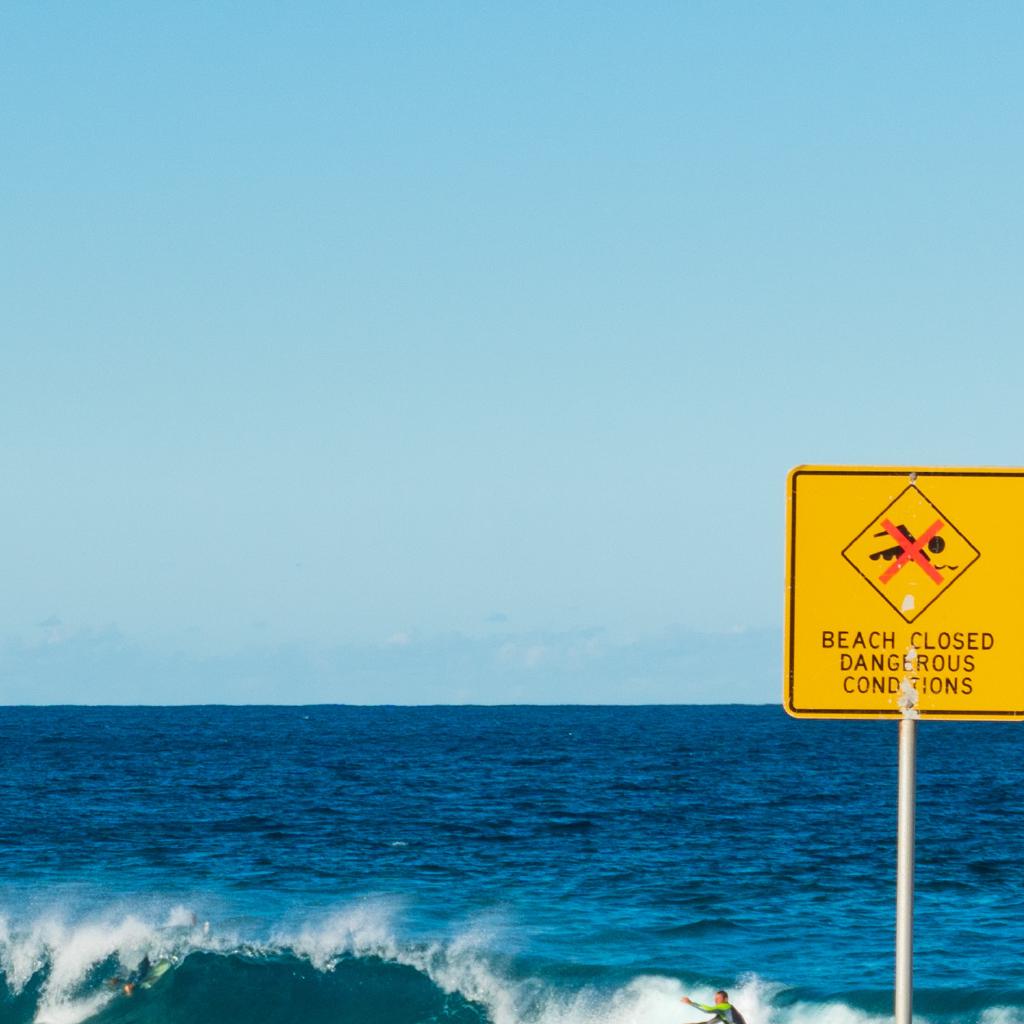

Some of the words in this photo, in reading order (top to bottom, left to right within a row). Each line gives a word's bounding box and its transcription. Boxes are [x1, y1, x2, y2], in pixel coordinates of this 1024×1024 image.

[822, 630, 895, 650] BEACH
[910, 631, 995, 650] CLOSED
[840, 653, 976, 672] DANGEROUS
[843, 676, 973, 694] CONDTIONS
